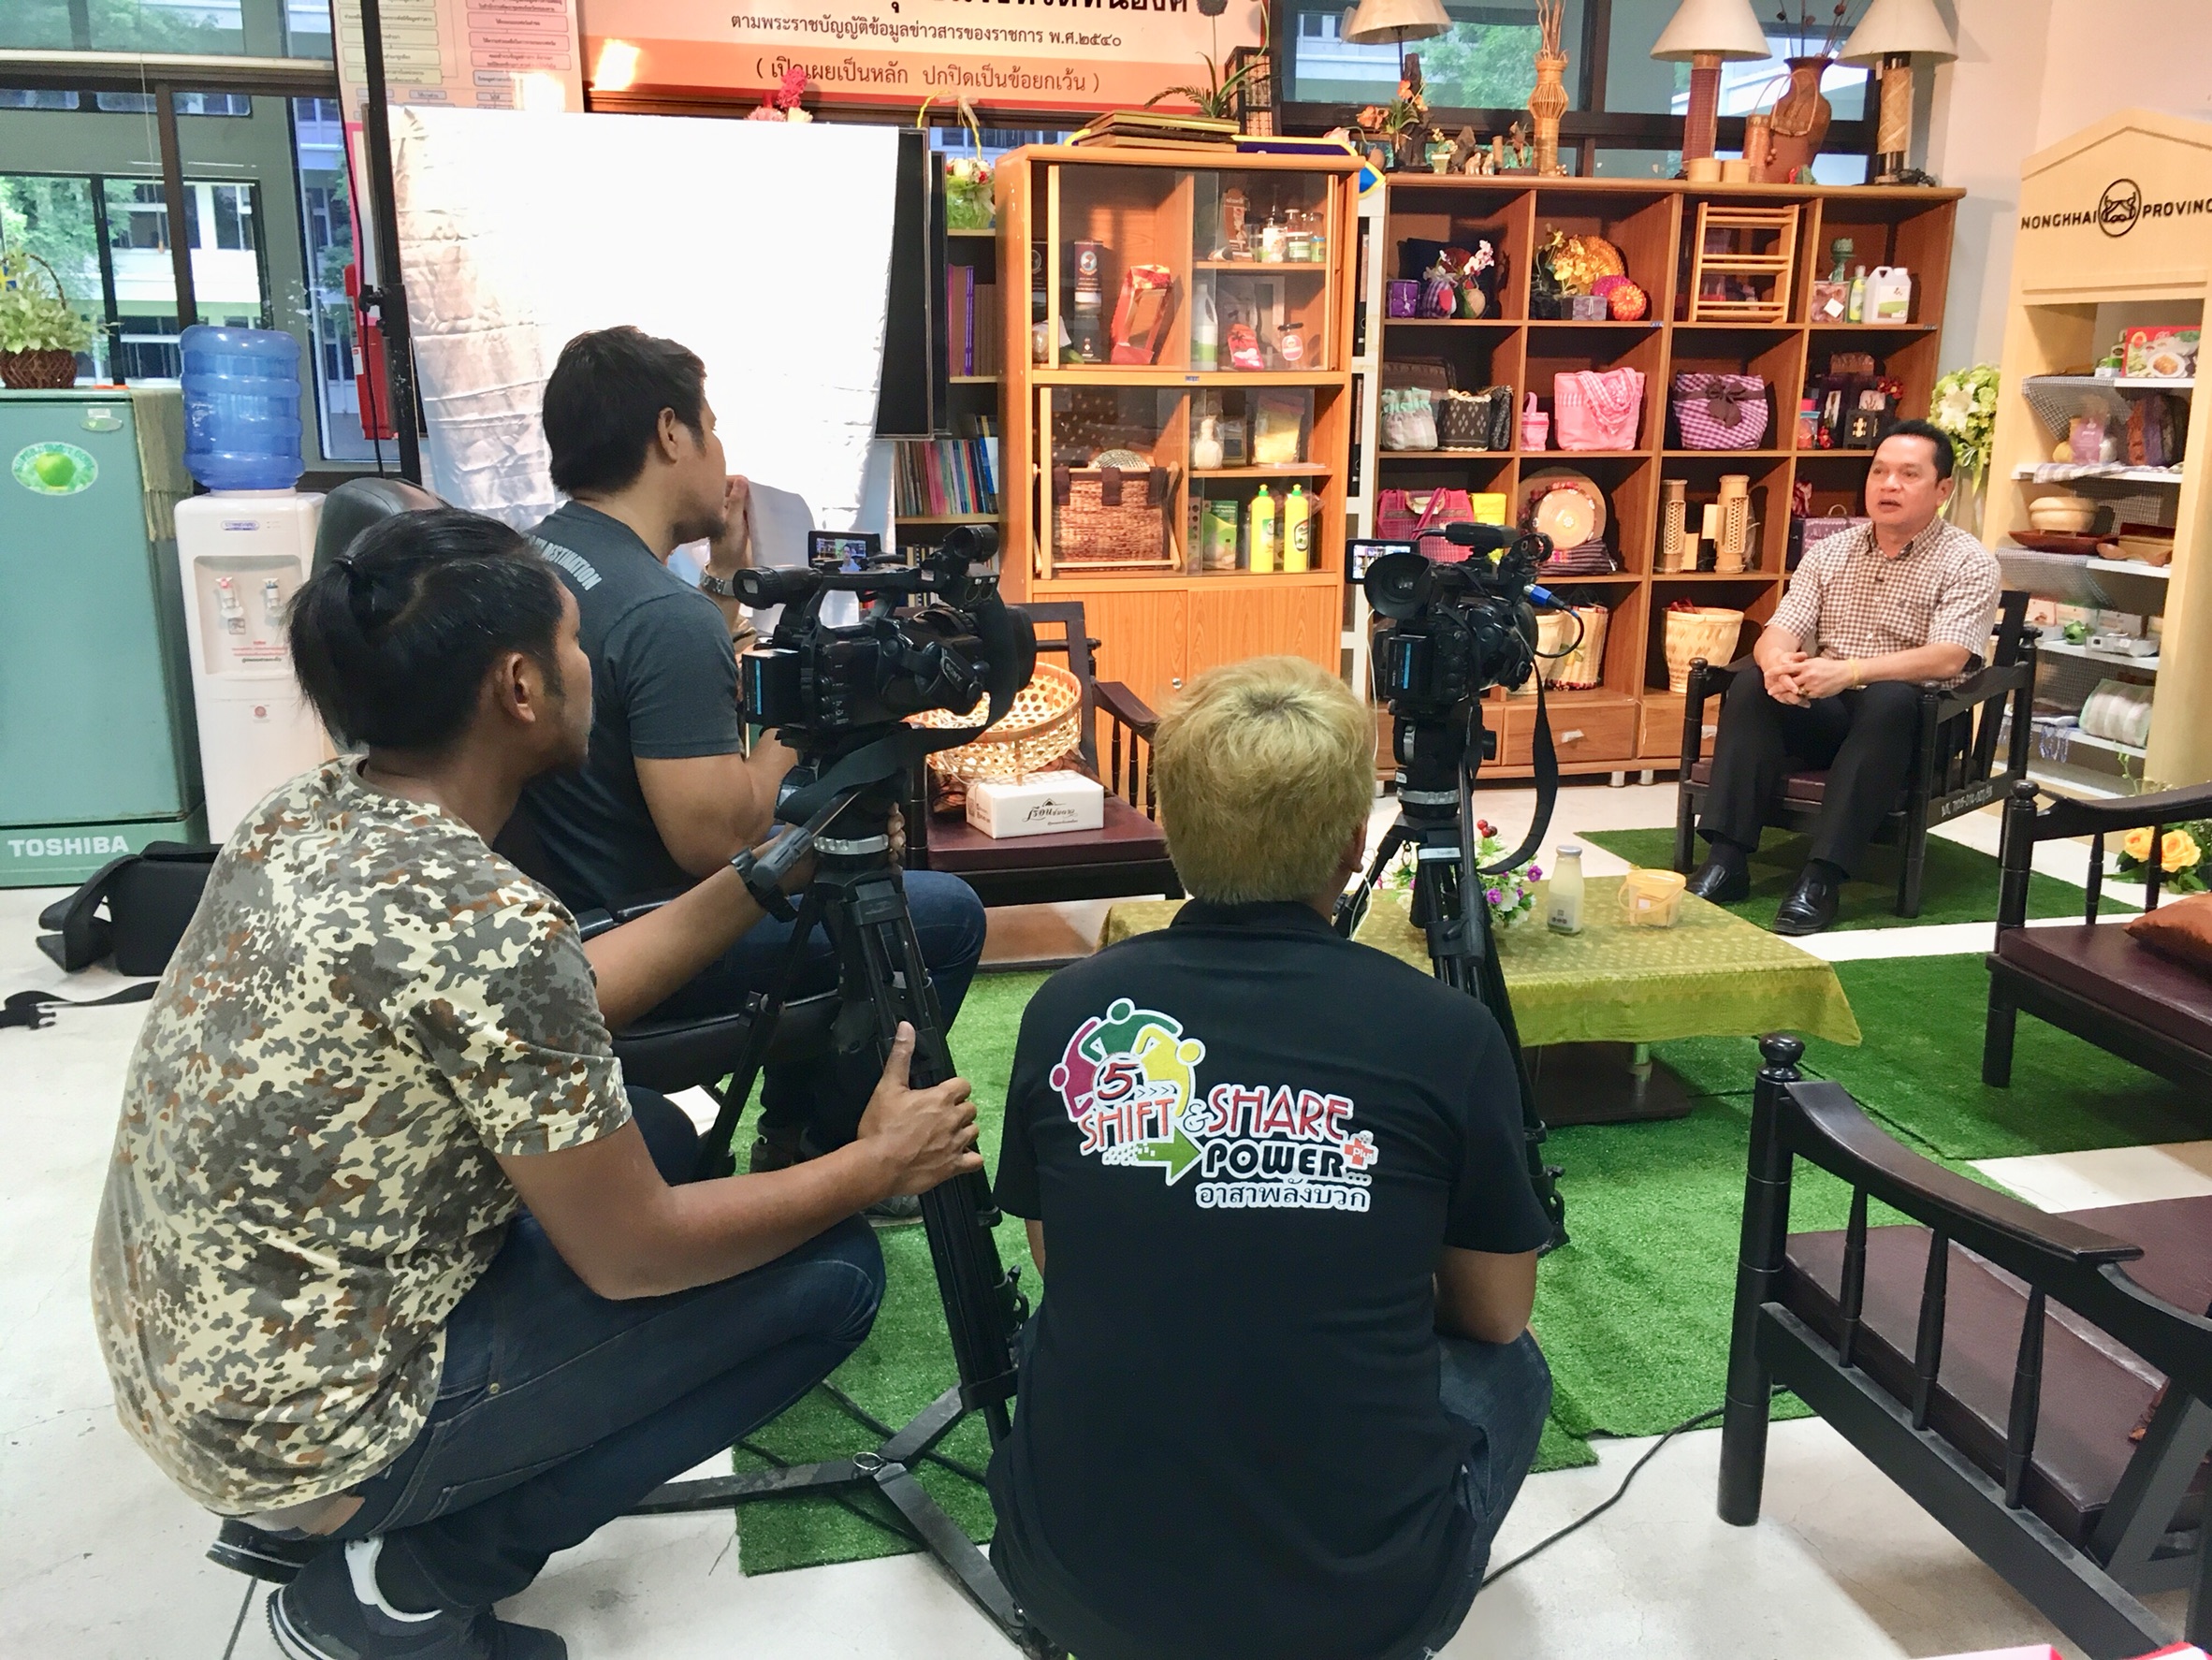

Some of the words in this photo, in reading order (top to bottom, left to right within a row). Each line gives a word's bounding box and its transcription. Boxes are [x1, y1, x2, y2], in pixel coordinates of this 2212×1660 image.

[731, 14, 1043, 43] ตามพระราชบัญญัติข้อมูลข่าวสารของราชการ
[1049, 31, 1122, 47] พ.ศ.๒๕๔๐
[923, 63, 1085, 92] ปกปิดเป็นข้อยกเว้น
[7, 836, 130, 857] TOSHIBA
[1098, 1062, 1141, 1100] 5
[1080, 1098, 1175, 1151] SHIFT
[1208, 1087, 1349, 1141] SHARE
[1200, 1177, 1366, 1208] อาสาพลังบวก
